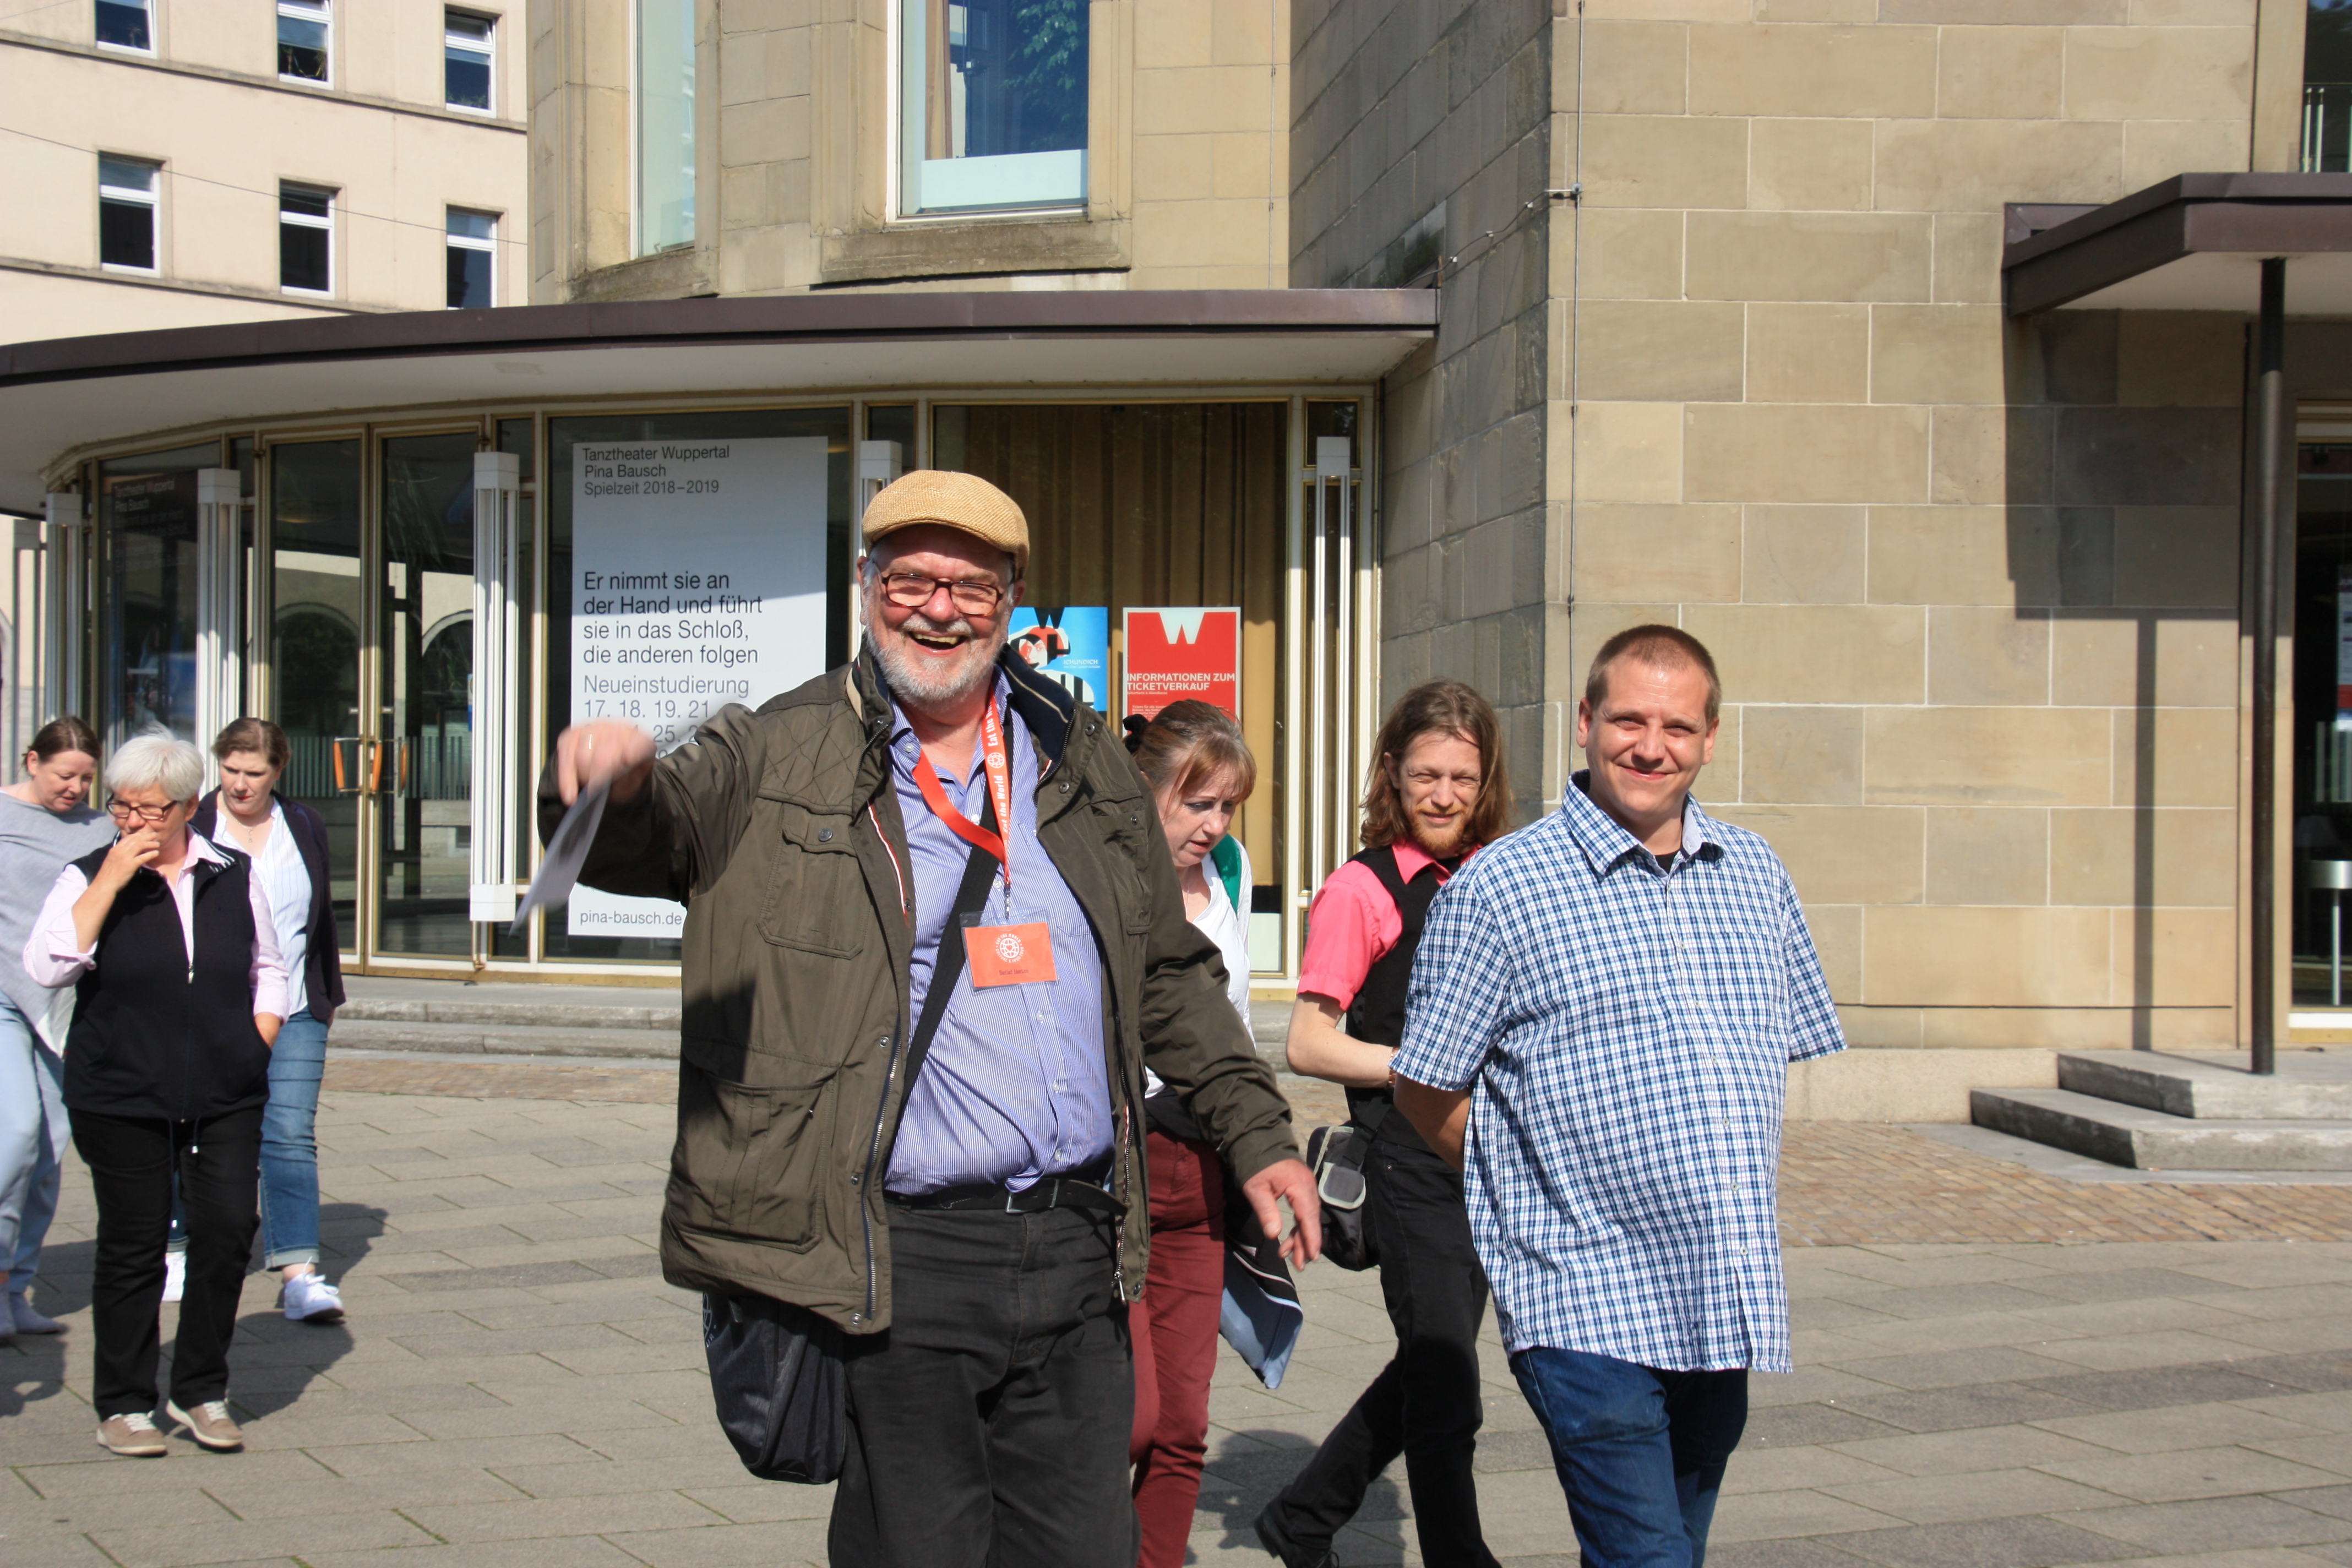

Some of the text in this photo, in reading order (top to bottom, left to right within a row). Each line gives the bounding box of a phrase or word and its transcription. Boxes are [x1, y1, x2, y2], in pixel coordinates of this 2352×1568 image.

[582, 445, 729, 462] Tanztheater Wuppertal
[585, 464, 666, 478] Pina Bausch
[585, 482, 639, 498] Spielzeit
[585, 571, 729, 590] Er nimmt sie an
[584, 595, 763, 614] der Hand und führt
[584, 619, 749, 641] sie in das Schloß,
[1158, 611, 1205, 644] W
[584, 645, 758, 668] die anderen folgen
[1127, 673, 1235, 682] INFORMATIONEN ZUM
[1127, 682, 1210, 690] TICKETVERKAUF
[584, 675, 749, 699] Neueinstudierung
[584, 700, 610, 717] 17.
[619, 700, 645, 717] 18.
[655, 700, 680, 718] 19.
[654, 725, 681, 742] 25.
[986, 718, 995, 733] the
[988, 733, 998, 747] Eat
[994, 775, 1006, 799] World
[580, 910, 682, 925] pina-bausch.de
